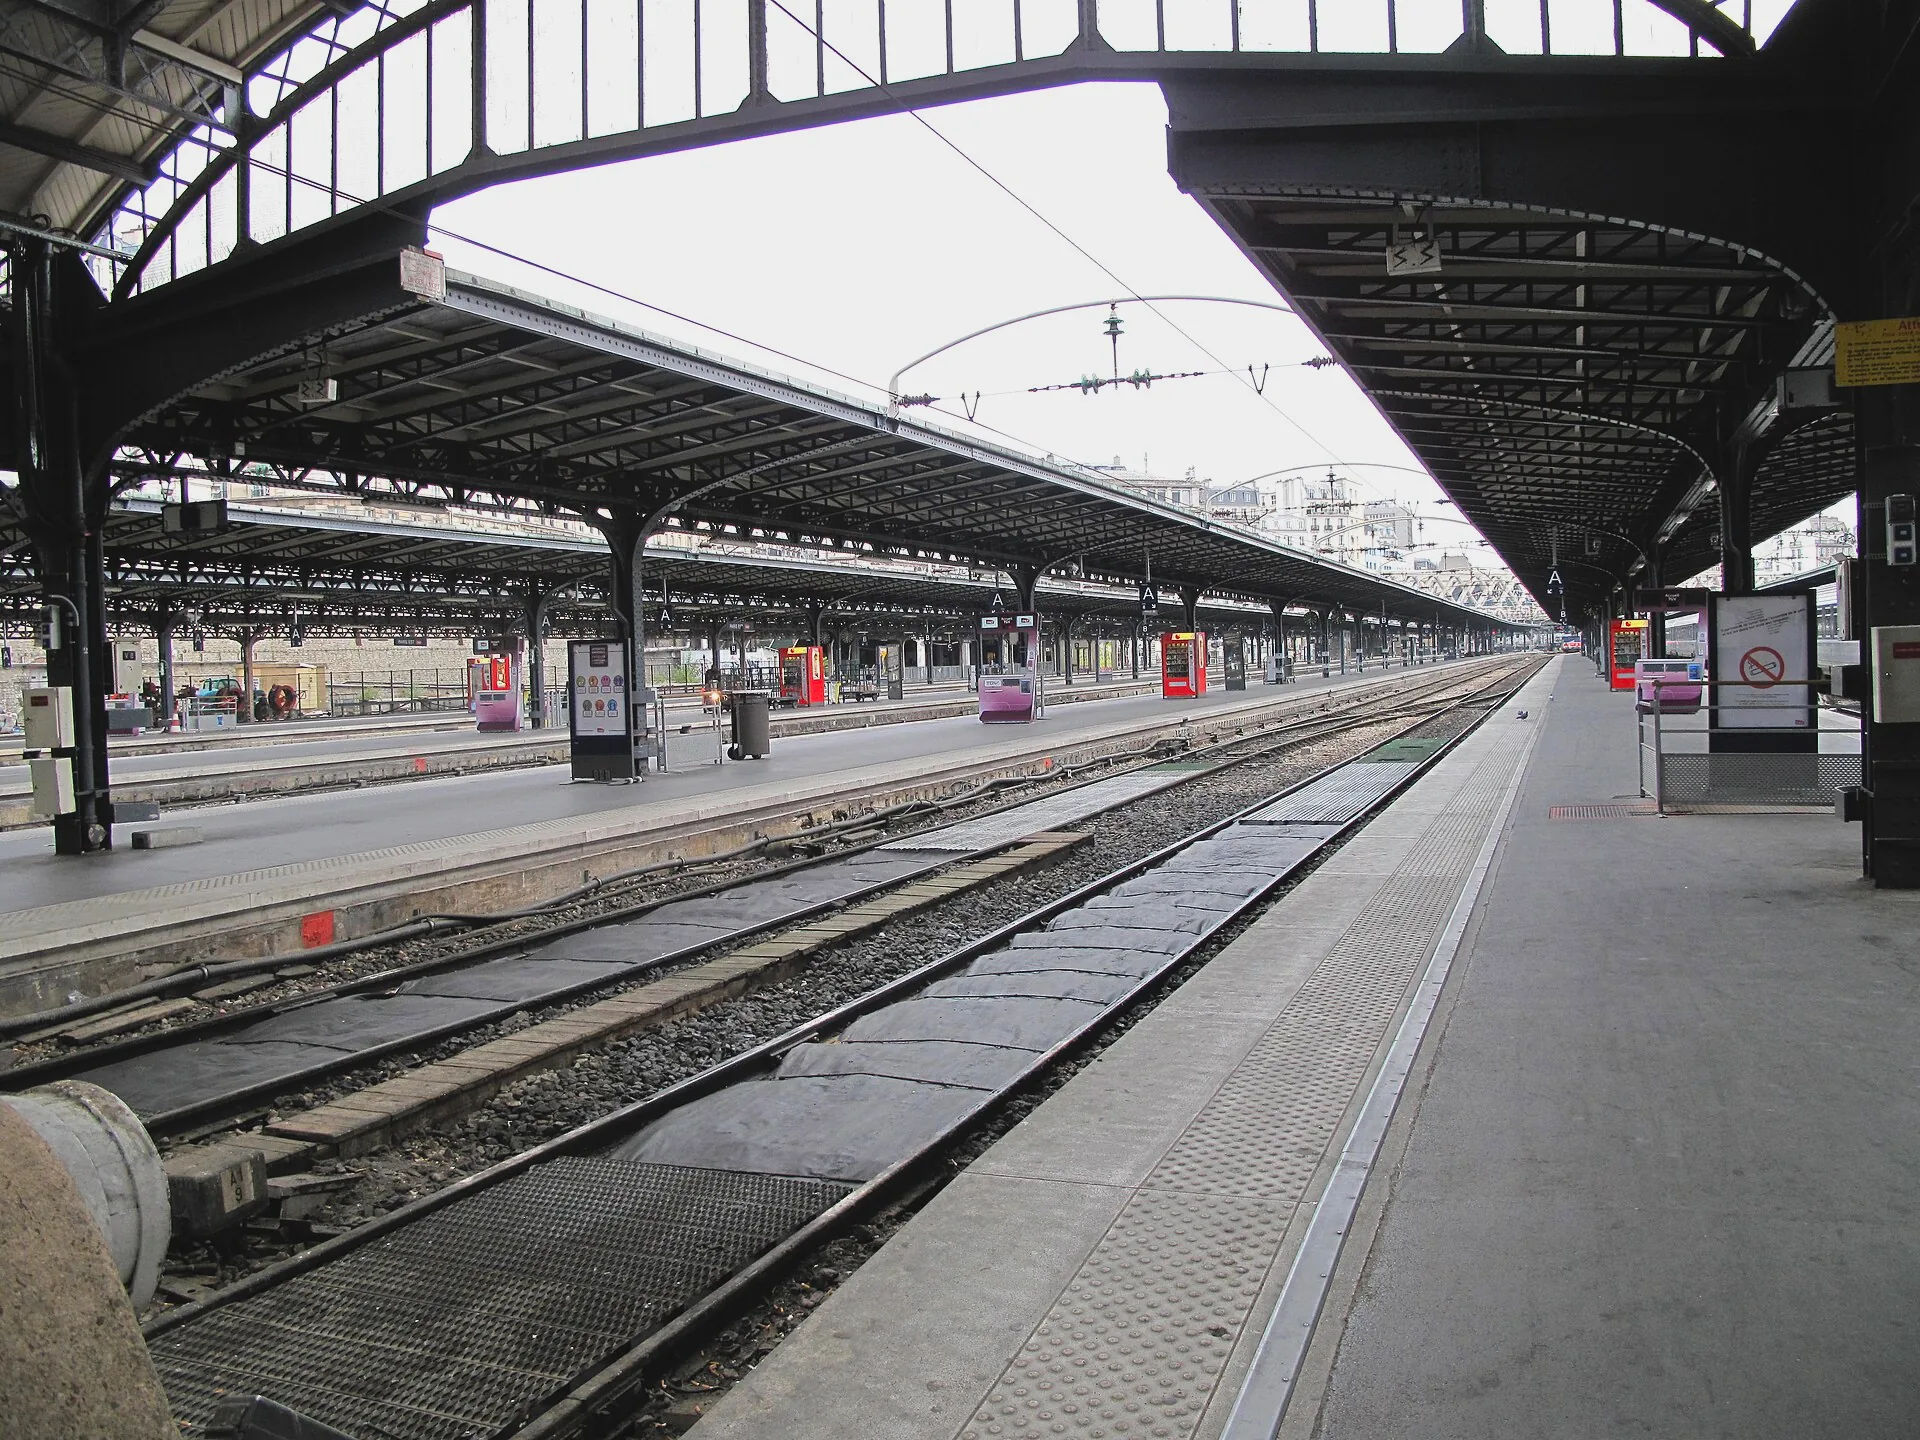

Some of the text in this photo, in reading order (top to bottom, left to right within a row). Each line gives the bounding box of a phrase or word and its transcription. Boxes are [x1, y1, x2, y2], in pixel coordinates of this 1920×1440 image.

[1548, 570, 1562, 585] A
[992, 593, 1003, 606] A
[1143, 587, 1155, 600] A
[541, 615, 551, 627] A
[661, 609, 671, 621] A
[195, 633, 202, 643] A
[292, 628, 300, 639] A
[3, 650, 9, 660] A
[235, 1187, 243, 1202] 9
